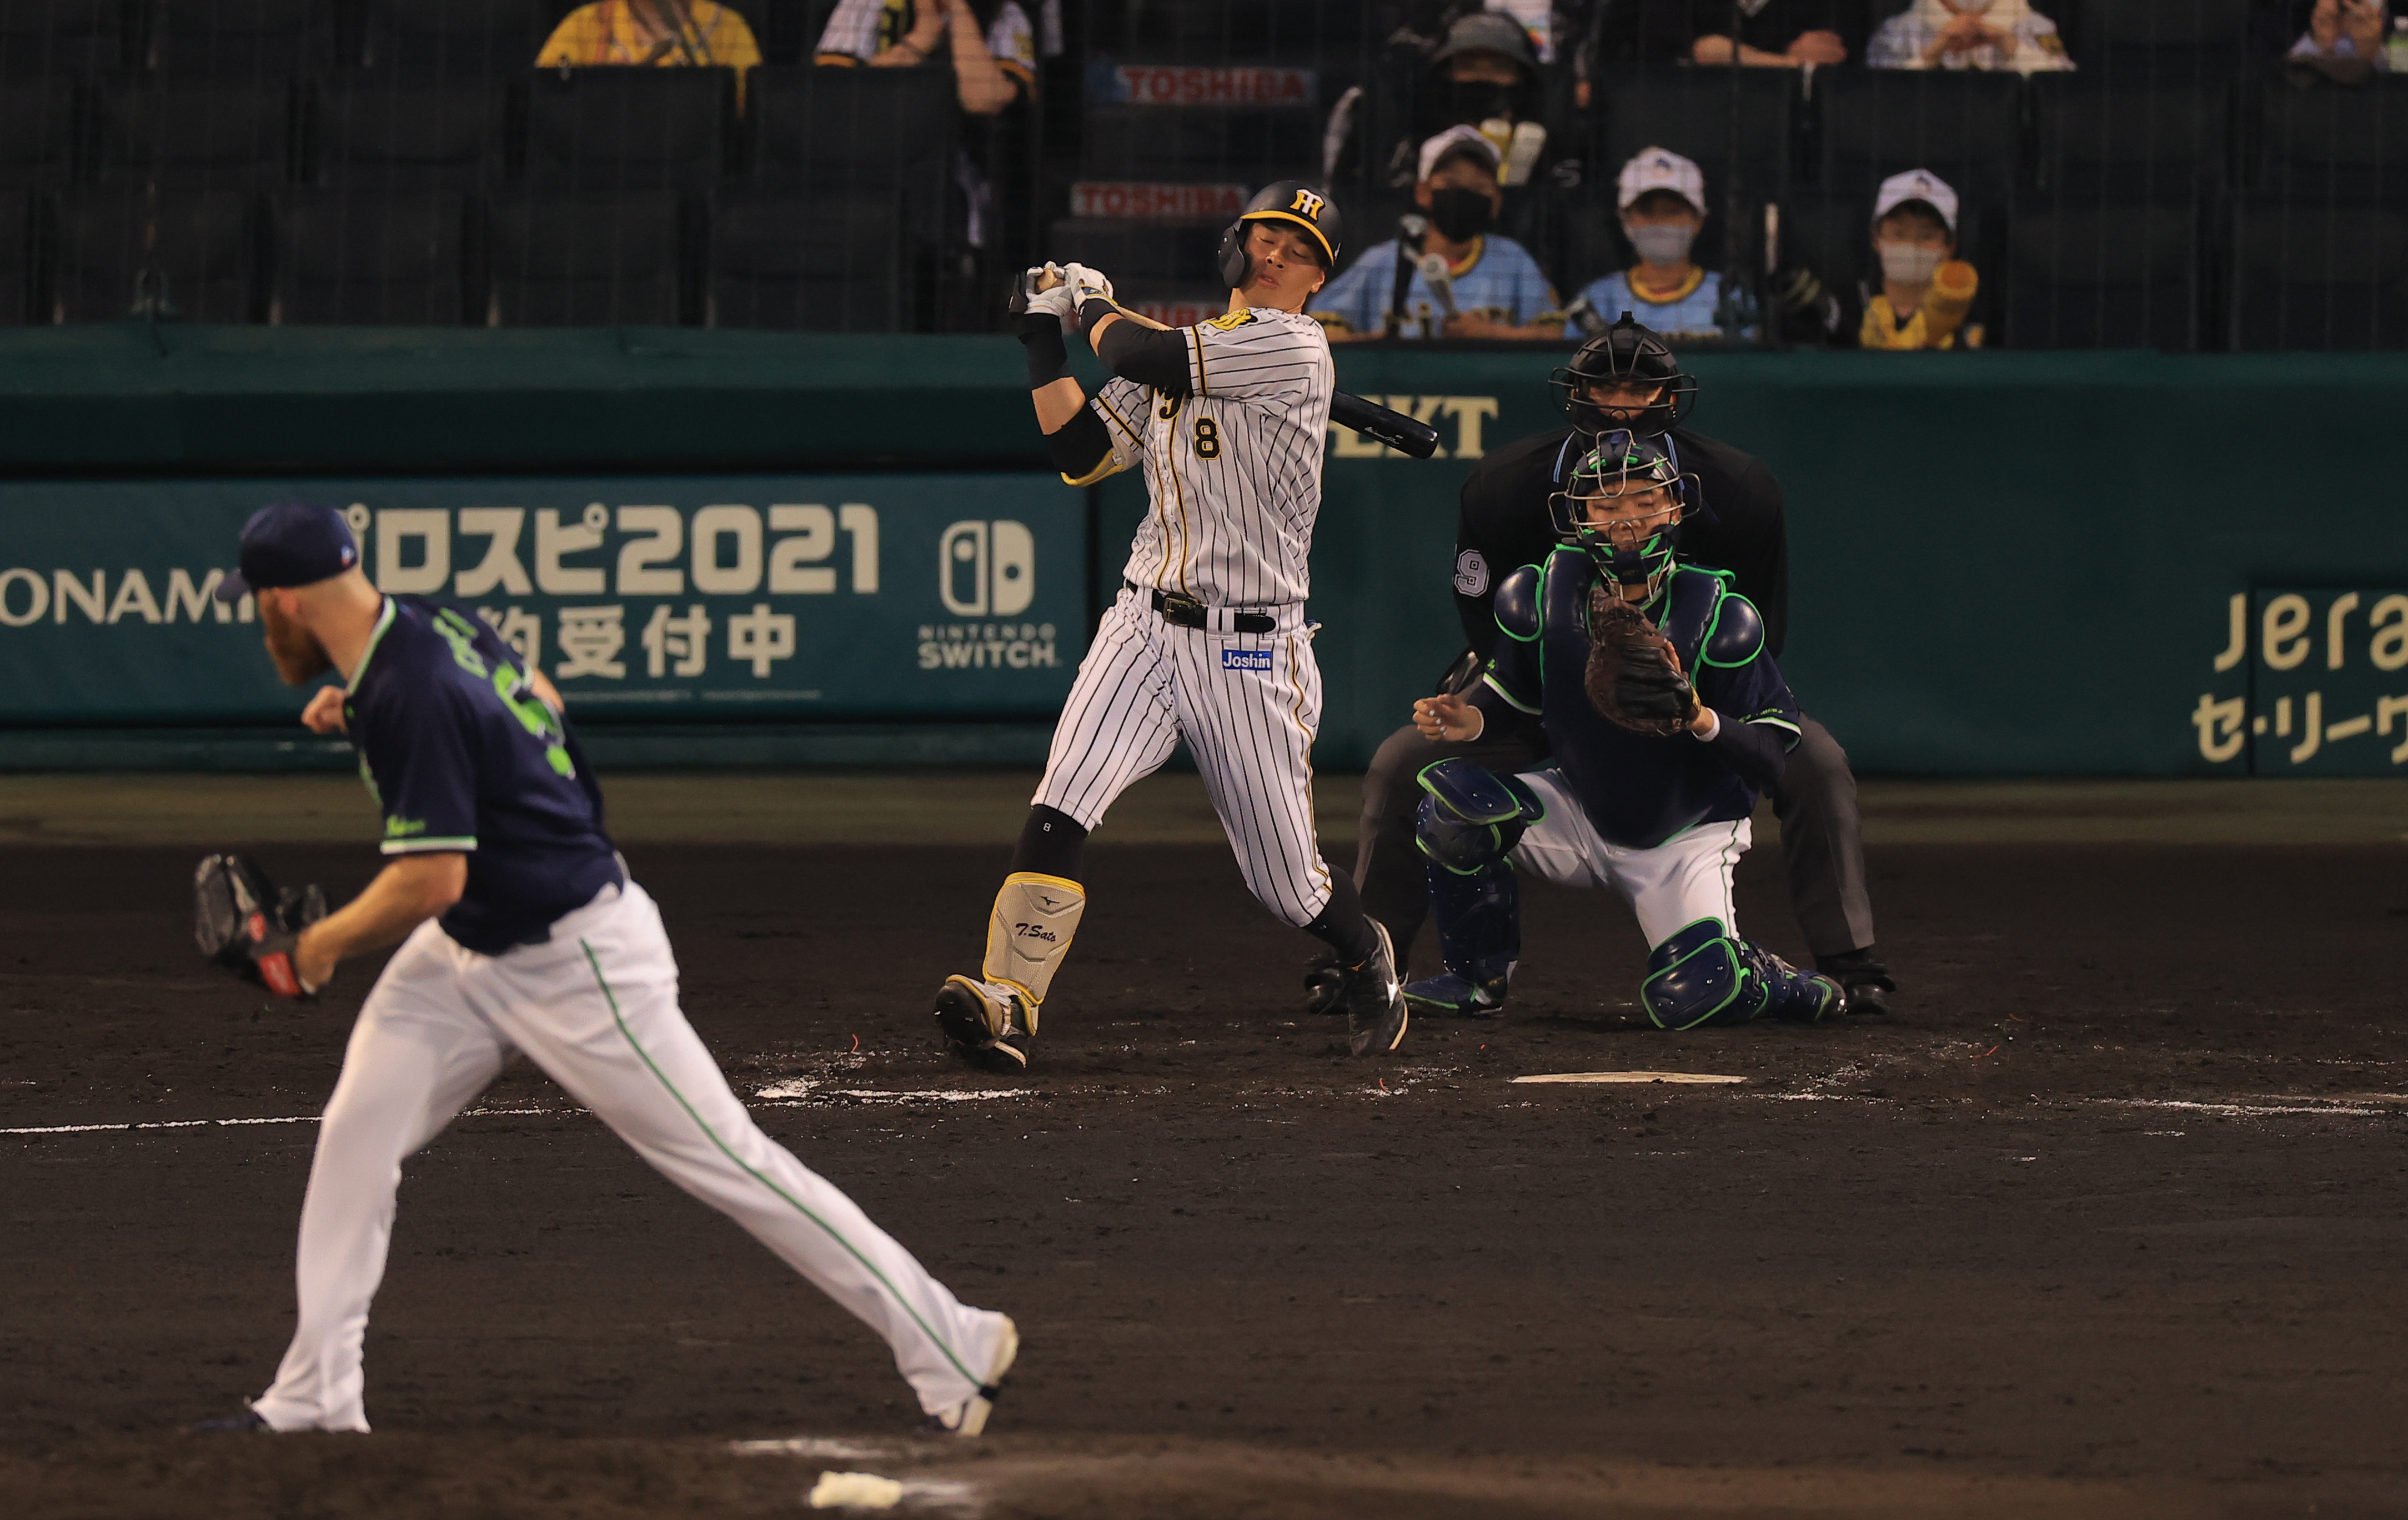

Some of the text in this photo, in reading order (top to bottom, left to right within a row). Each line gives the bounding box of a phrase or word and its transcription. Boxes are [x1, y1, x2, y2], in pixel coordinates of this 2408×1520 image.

[1125, 69, 1305, 101] TOSHIBA
[1082, 189, 1243, 215] TOSHIBA
[1195, 417, 1222, 460] 8
[1454, 549, 1490, 597] 9
[917, 623, 1056, 639] NINTENDO
[917, 641, 1056, 669] SWITCH
[1223, 651, 1271, 668] Joshin
[1043, 822, 1051, 832] 8
[1016, 922, 1056, 942] T.Sato
